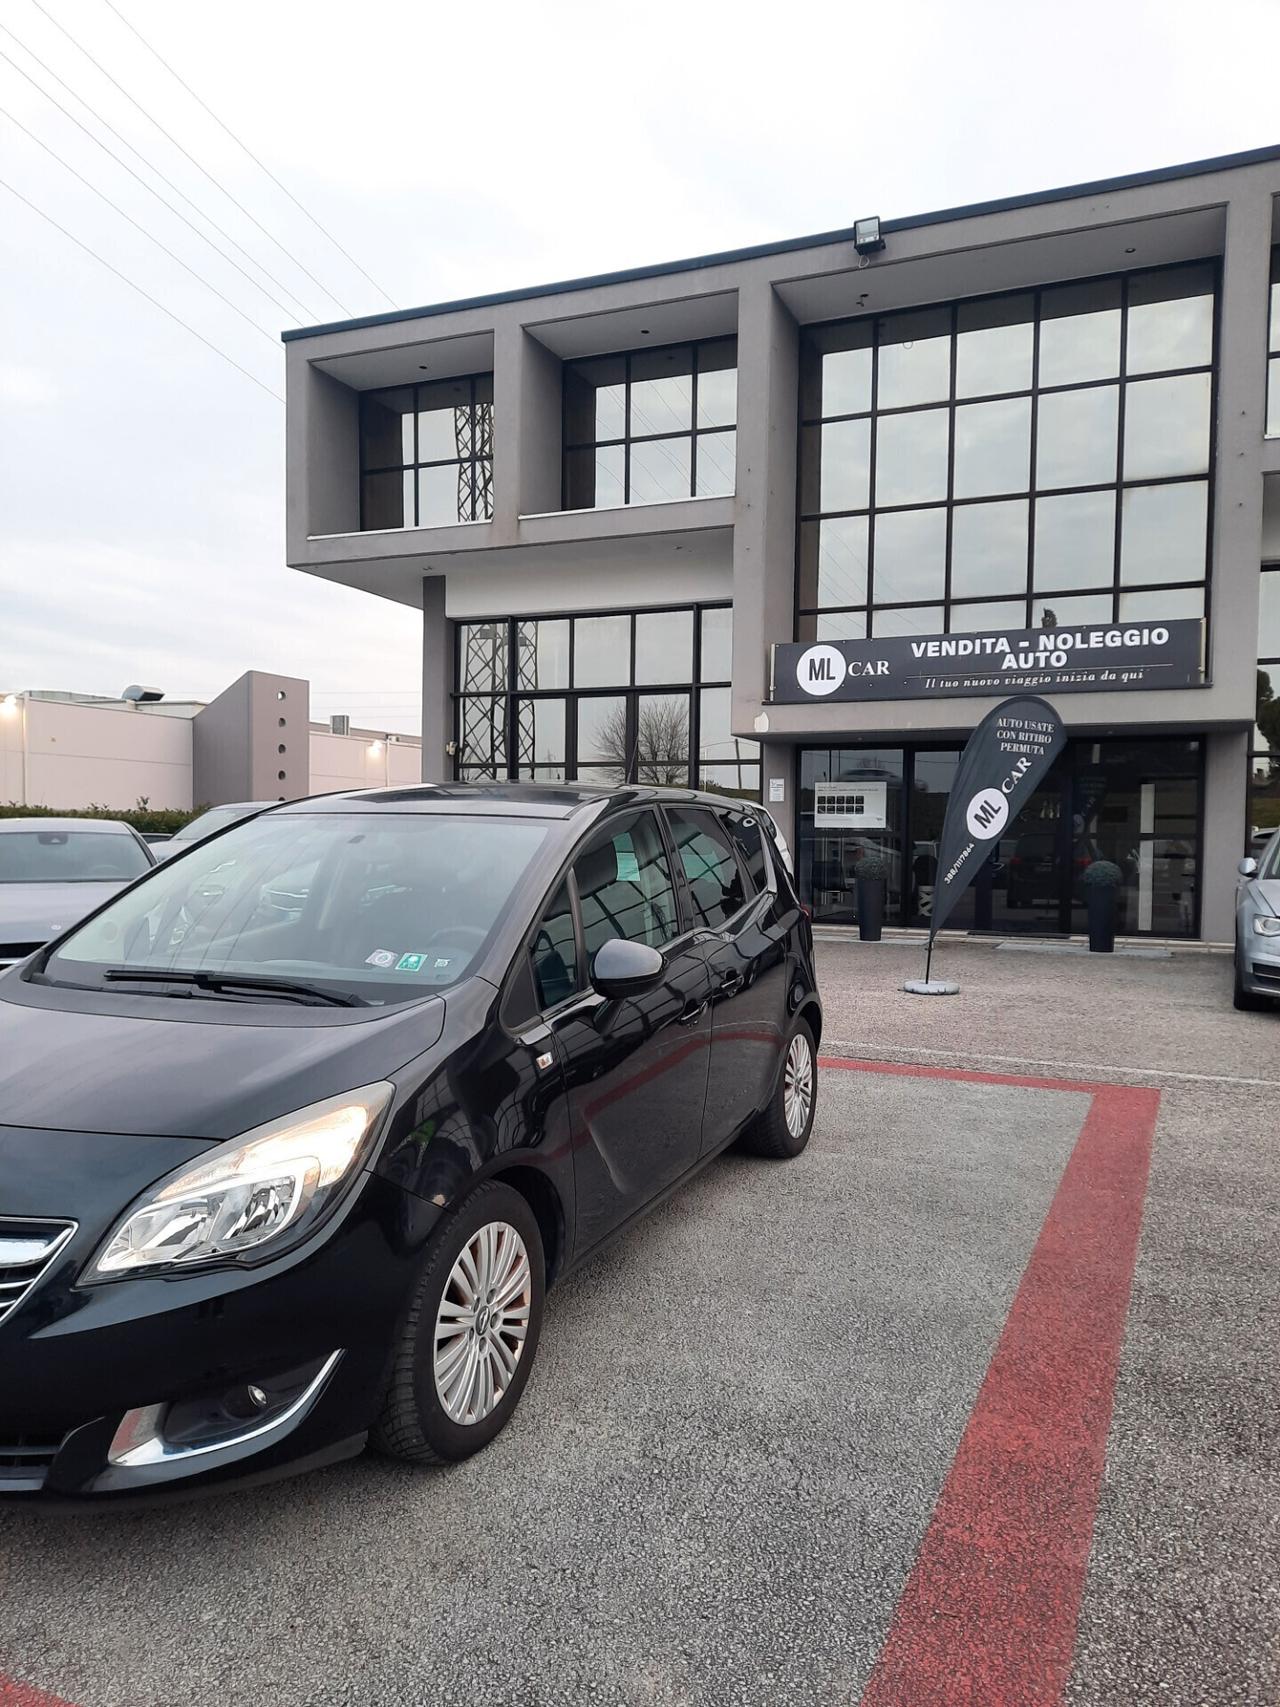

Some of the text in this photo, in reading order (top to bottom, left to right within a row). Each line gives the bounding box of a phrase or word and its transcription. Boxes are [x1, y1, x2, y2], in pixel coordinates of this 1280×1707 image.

[911, 637, 1011, 658] VENDITA
[1038, 628, 1170, 651] NOLEGGIO
[809, 657, 890, 681] ML CAR
[1001, 651, 1068, 670] AUTO
[925, 668, 1144, 689] Il tuo nuovo viaggio inizia da qui
[997, 718, 1054, 733] AUTO USATE
[996, 730, 1052, 744] CON RITIRO
[1000, 742, 1045, 755] PERMUTA
[973, 757, 1033, 829] ML CAR
